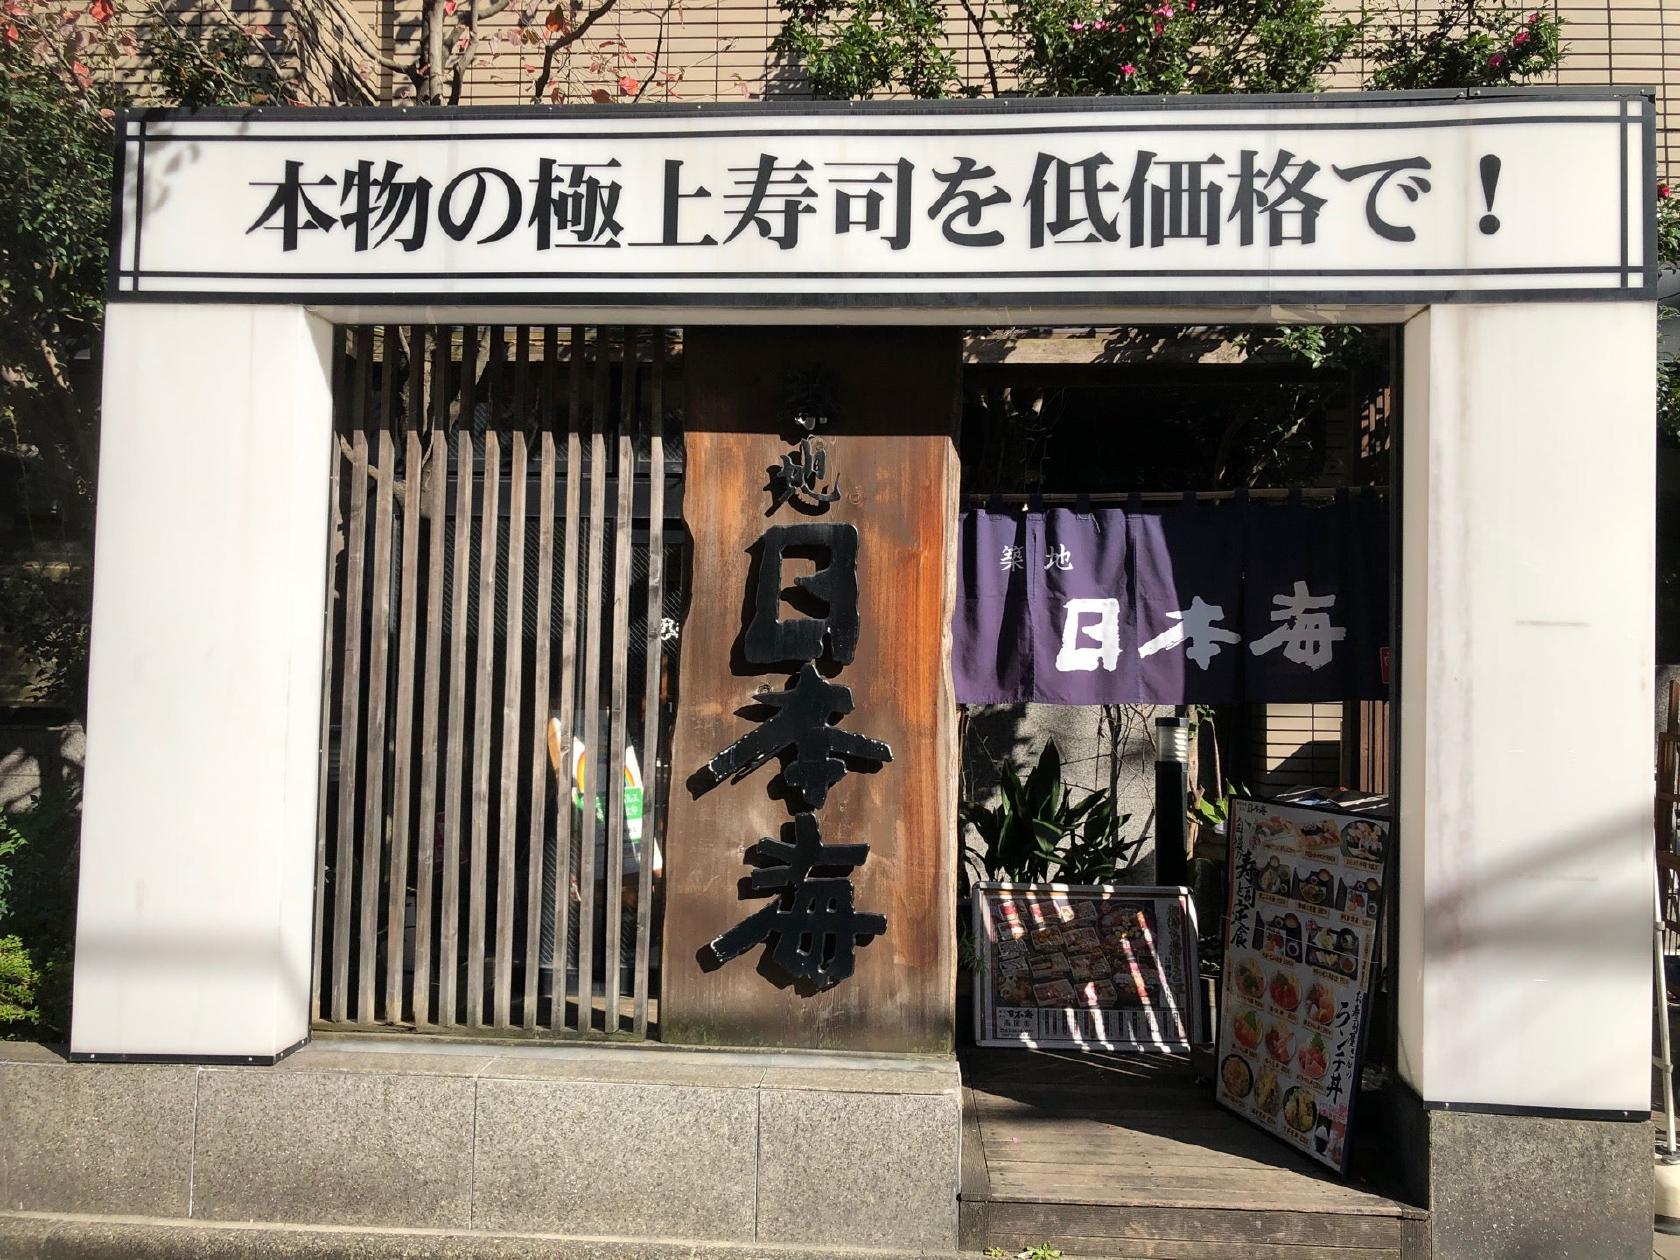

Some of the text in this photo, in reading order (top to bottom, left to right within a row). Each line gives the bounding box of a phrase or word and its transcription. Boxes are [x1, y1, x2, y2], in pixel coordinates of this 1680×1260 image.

[246, 149, 1501, 252] 本物の極上寿司を低価格で！
[1000, 543, 1074, 571] 築地
[1055, 580, 1347, 672] 日本海
[708, 523, 895, 988] 日本海
